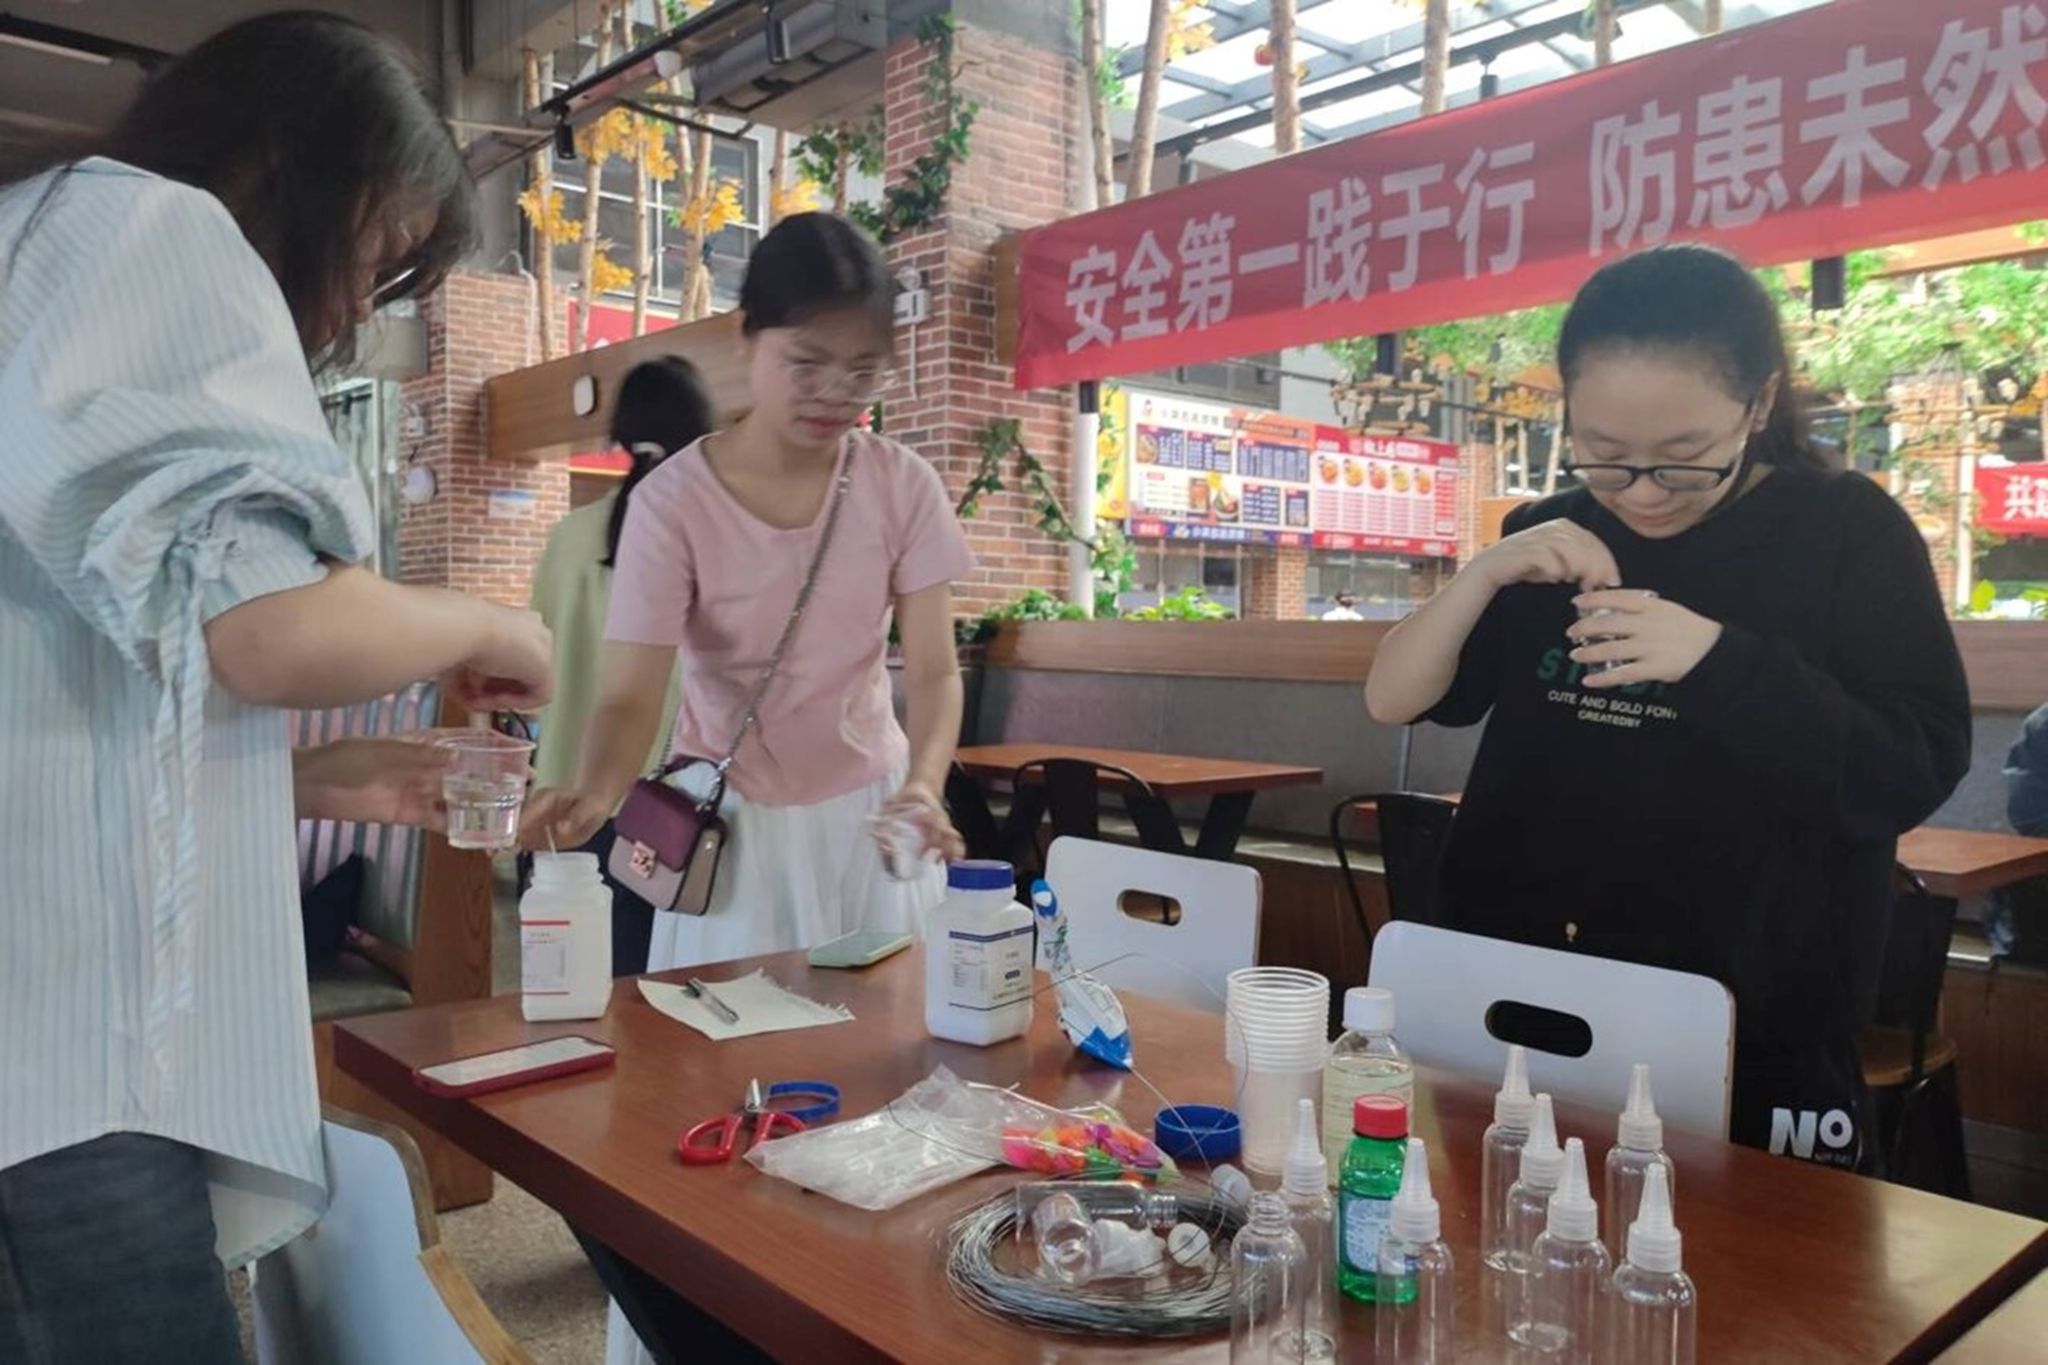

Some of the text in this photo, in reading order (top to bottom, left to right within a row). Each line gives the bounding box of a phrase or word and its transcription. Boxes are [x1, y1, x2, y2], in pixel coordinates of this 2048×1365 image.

[1065, 3, 2048, 355] 安全第一践于行 防患未然
[1548, 690, 1577, 705] CUTE
[1580, 695, 1607, 710] AND
[1609, 699, 1643, 716] BOLD
